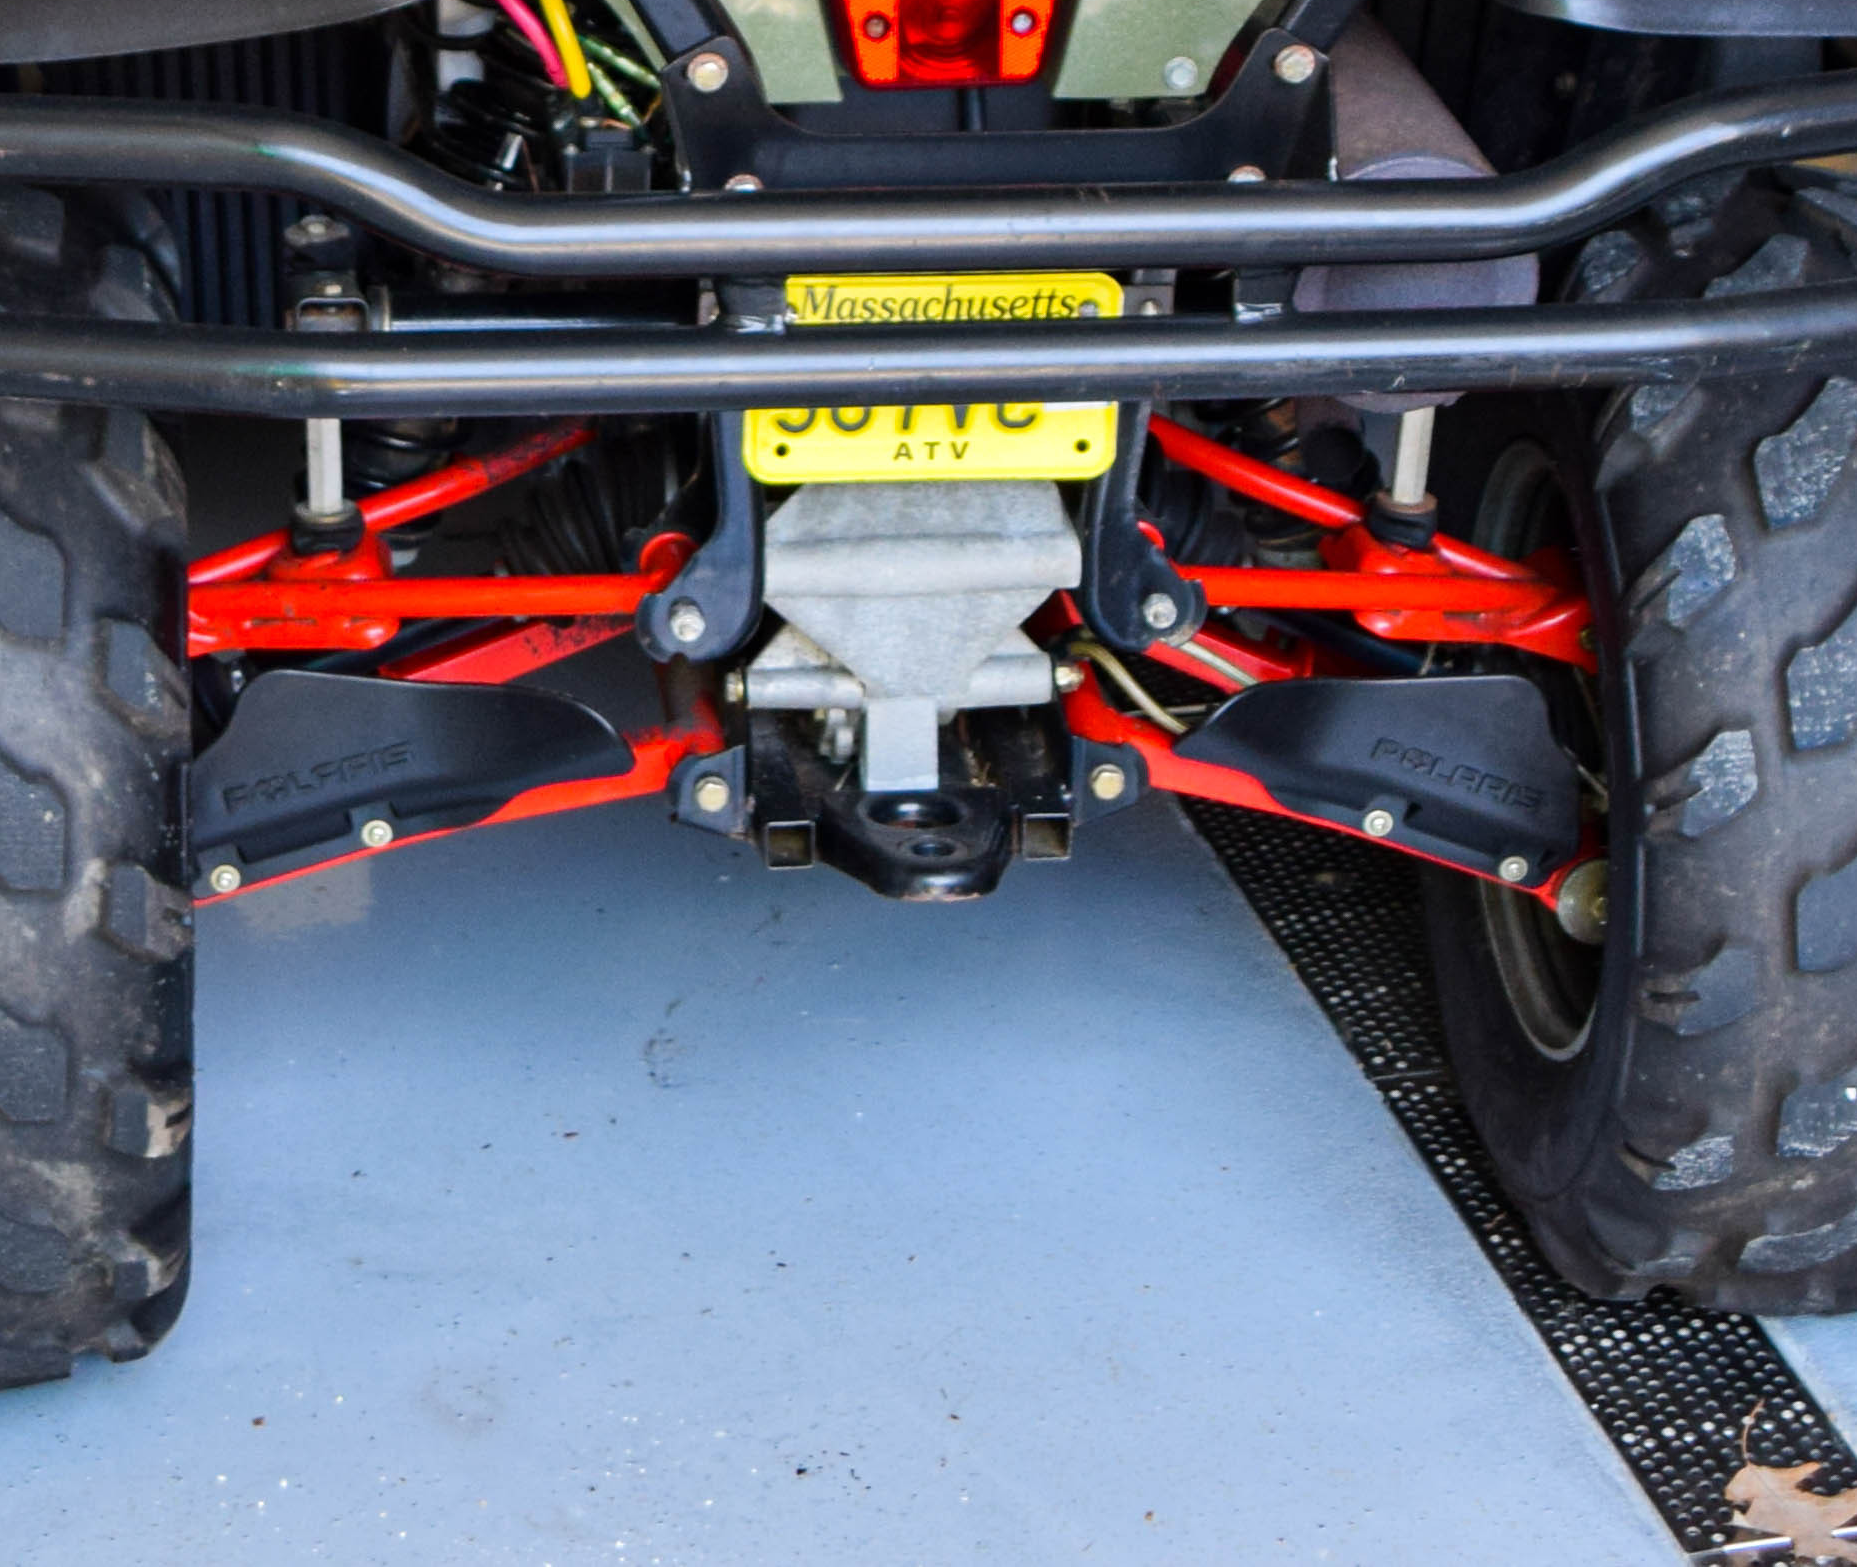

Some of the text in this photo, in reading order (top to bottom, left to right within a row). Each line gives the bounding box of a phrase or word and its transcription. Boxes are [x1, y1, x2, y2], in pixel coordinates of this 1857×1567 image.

[800, 283, 1079, 323] Massachusetts
[893, 441, 970, 462] ATV
[219, 739, 415, 816] POLARIS
[1370, 735, 1548, 812] POLARIS
